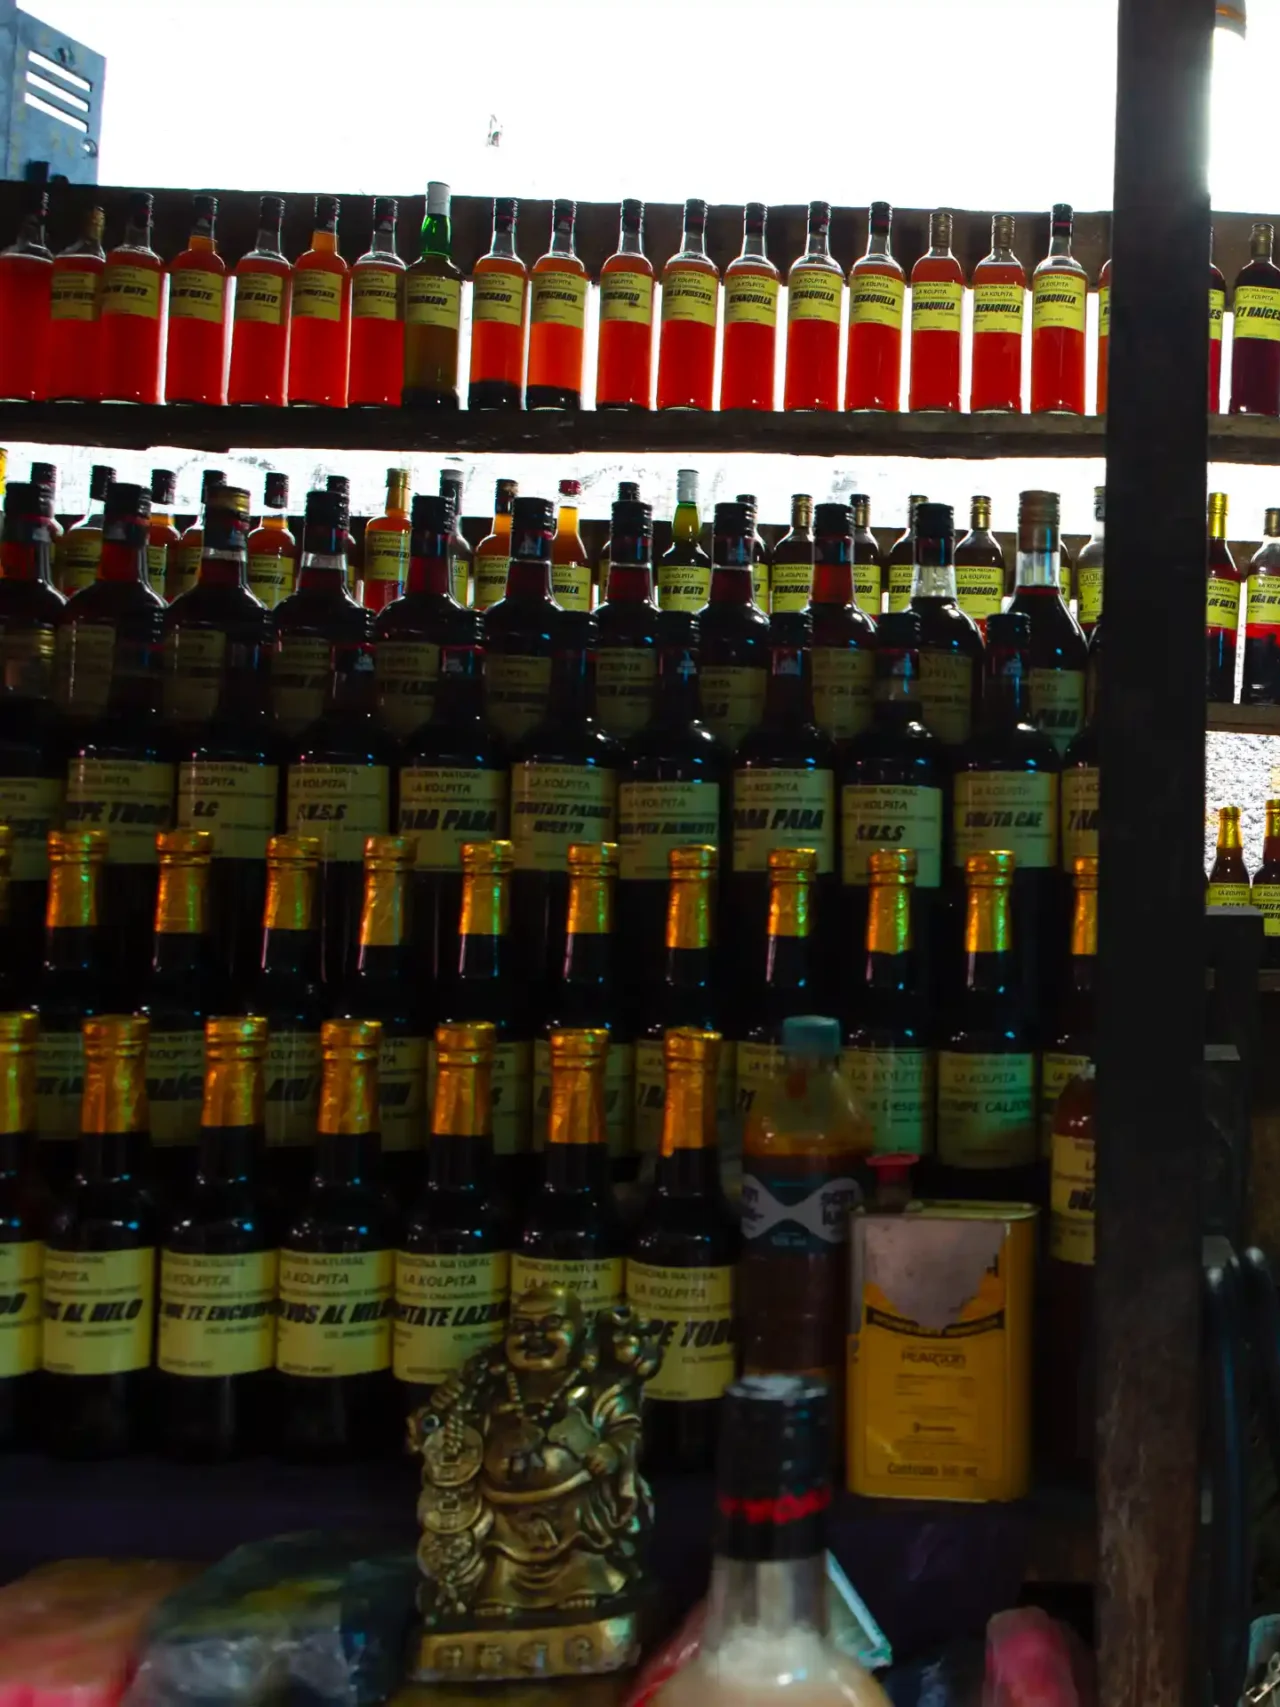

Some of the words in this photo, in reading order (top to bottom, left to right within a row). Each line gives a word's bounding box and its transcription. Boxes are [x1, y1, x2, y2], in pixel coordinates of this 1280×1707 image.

[425, 783, 471, 793] KOLPITA
[546, 779, 594, 790] KOLPITA
[419, 1274, 477, 1287] KOLPITA
[650, 1285, 706, 1299] KOLPITA
